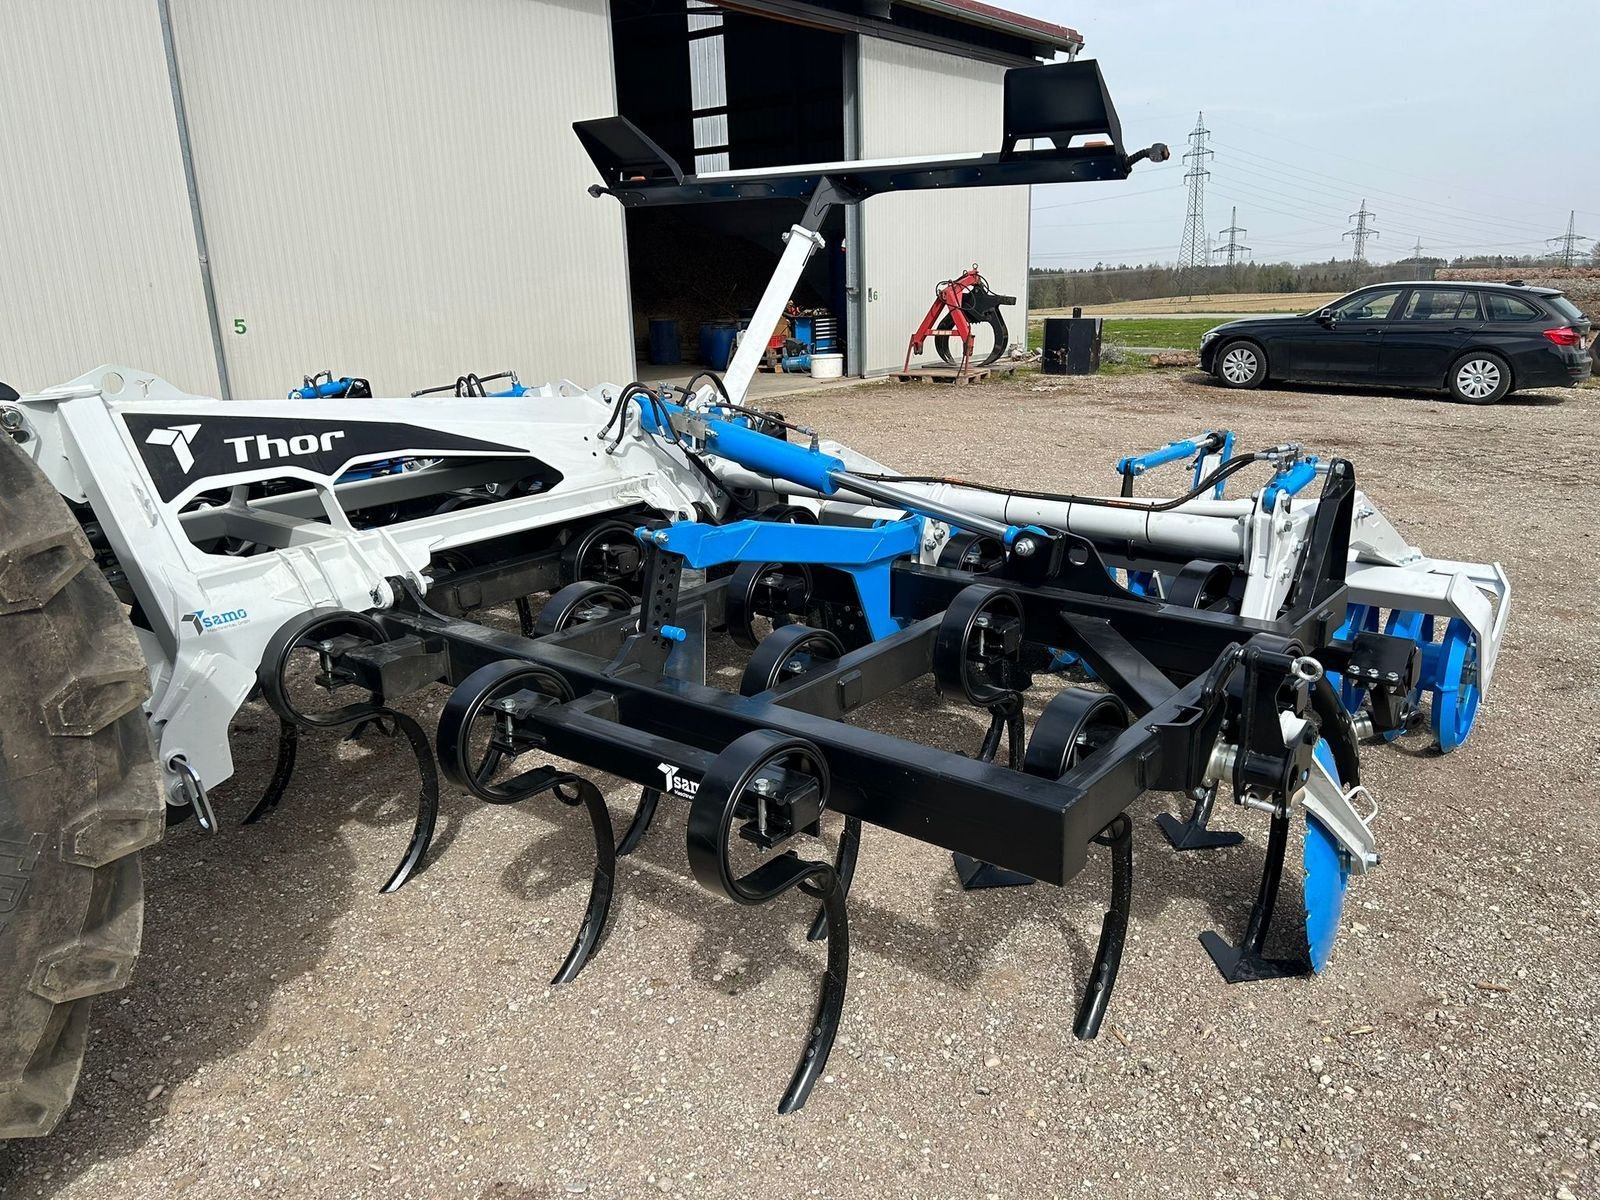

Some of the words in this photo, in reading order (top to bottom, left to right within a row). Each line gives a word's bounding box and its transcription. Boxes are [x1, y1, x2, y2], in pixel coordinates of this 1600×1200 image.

[873, 290, 879, 301] 6
[234, 319, 247, 334] 5
[223, 430, 345, 463] Thor
